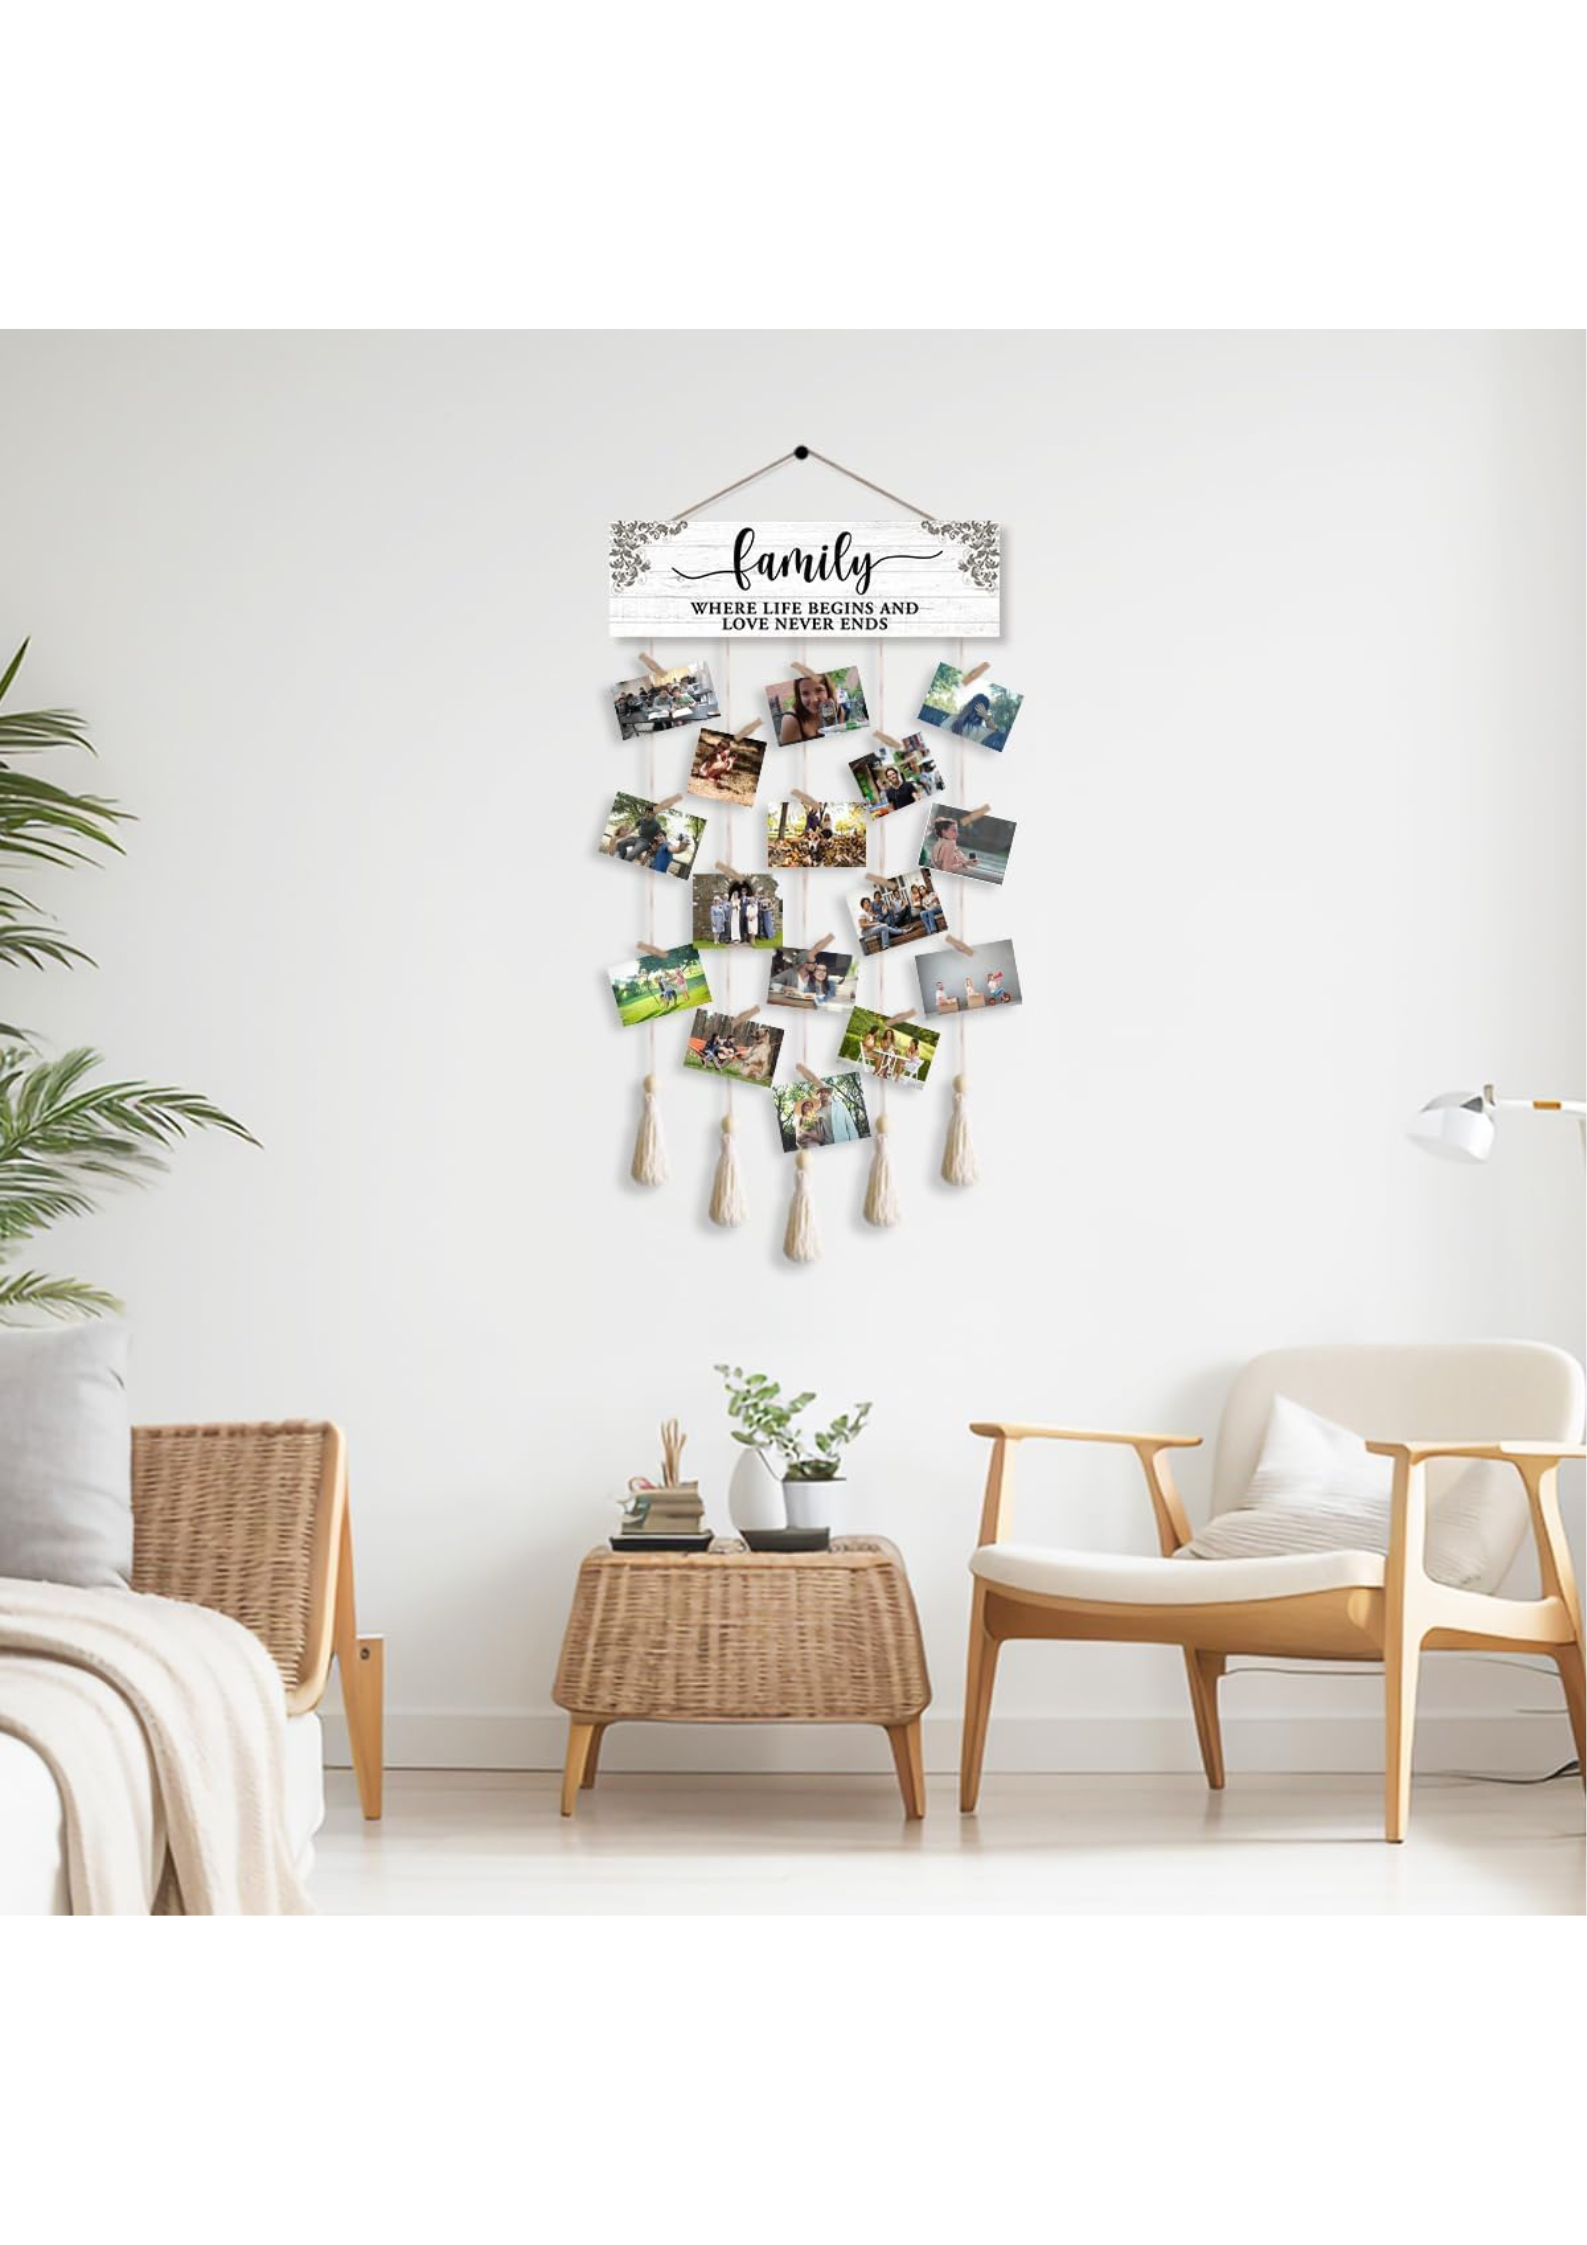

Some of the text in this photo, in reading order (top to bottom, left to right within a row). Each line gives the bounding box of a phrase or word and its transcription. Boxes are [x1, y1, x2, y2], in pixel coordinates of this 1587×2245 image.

[671, 527, 944, 595] family
[690, 602, 920, 615] WHERE LIFE BEGINS AND
[722, 617, 889, 631] LOVE NEVER ENDS
